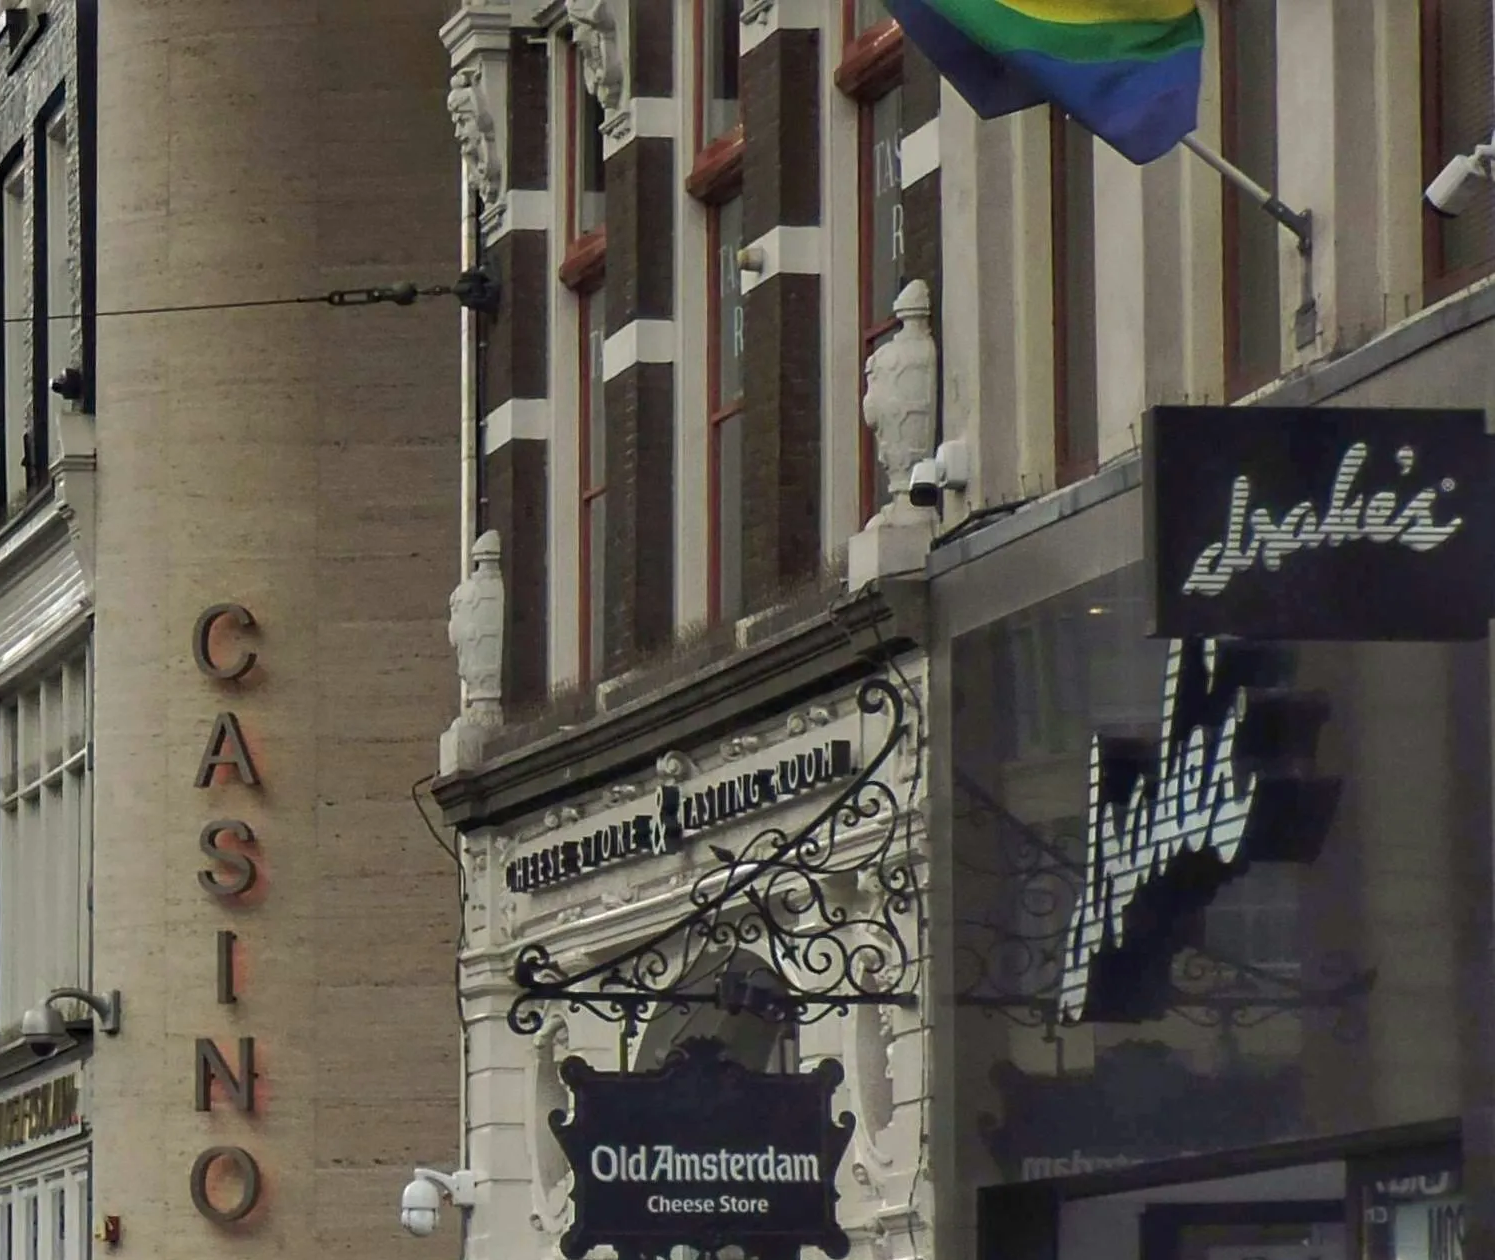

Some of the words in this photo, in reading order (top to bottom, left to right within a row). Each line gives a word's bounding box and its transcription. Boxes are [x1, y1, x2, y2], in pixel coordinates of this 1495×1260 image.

[505, 842, 568, 890] HEESE
[190, 602, 262, 1224] CASINO
[590, 1144, 647, 1183] Old
[651, 1144, 821, 1183] Amsterdam
[647, 1195, 715, 1214] Cheese
[719, 1195, 769, 1214] Store
